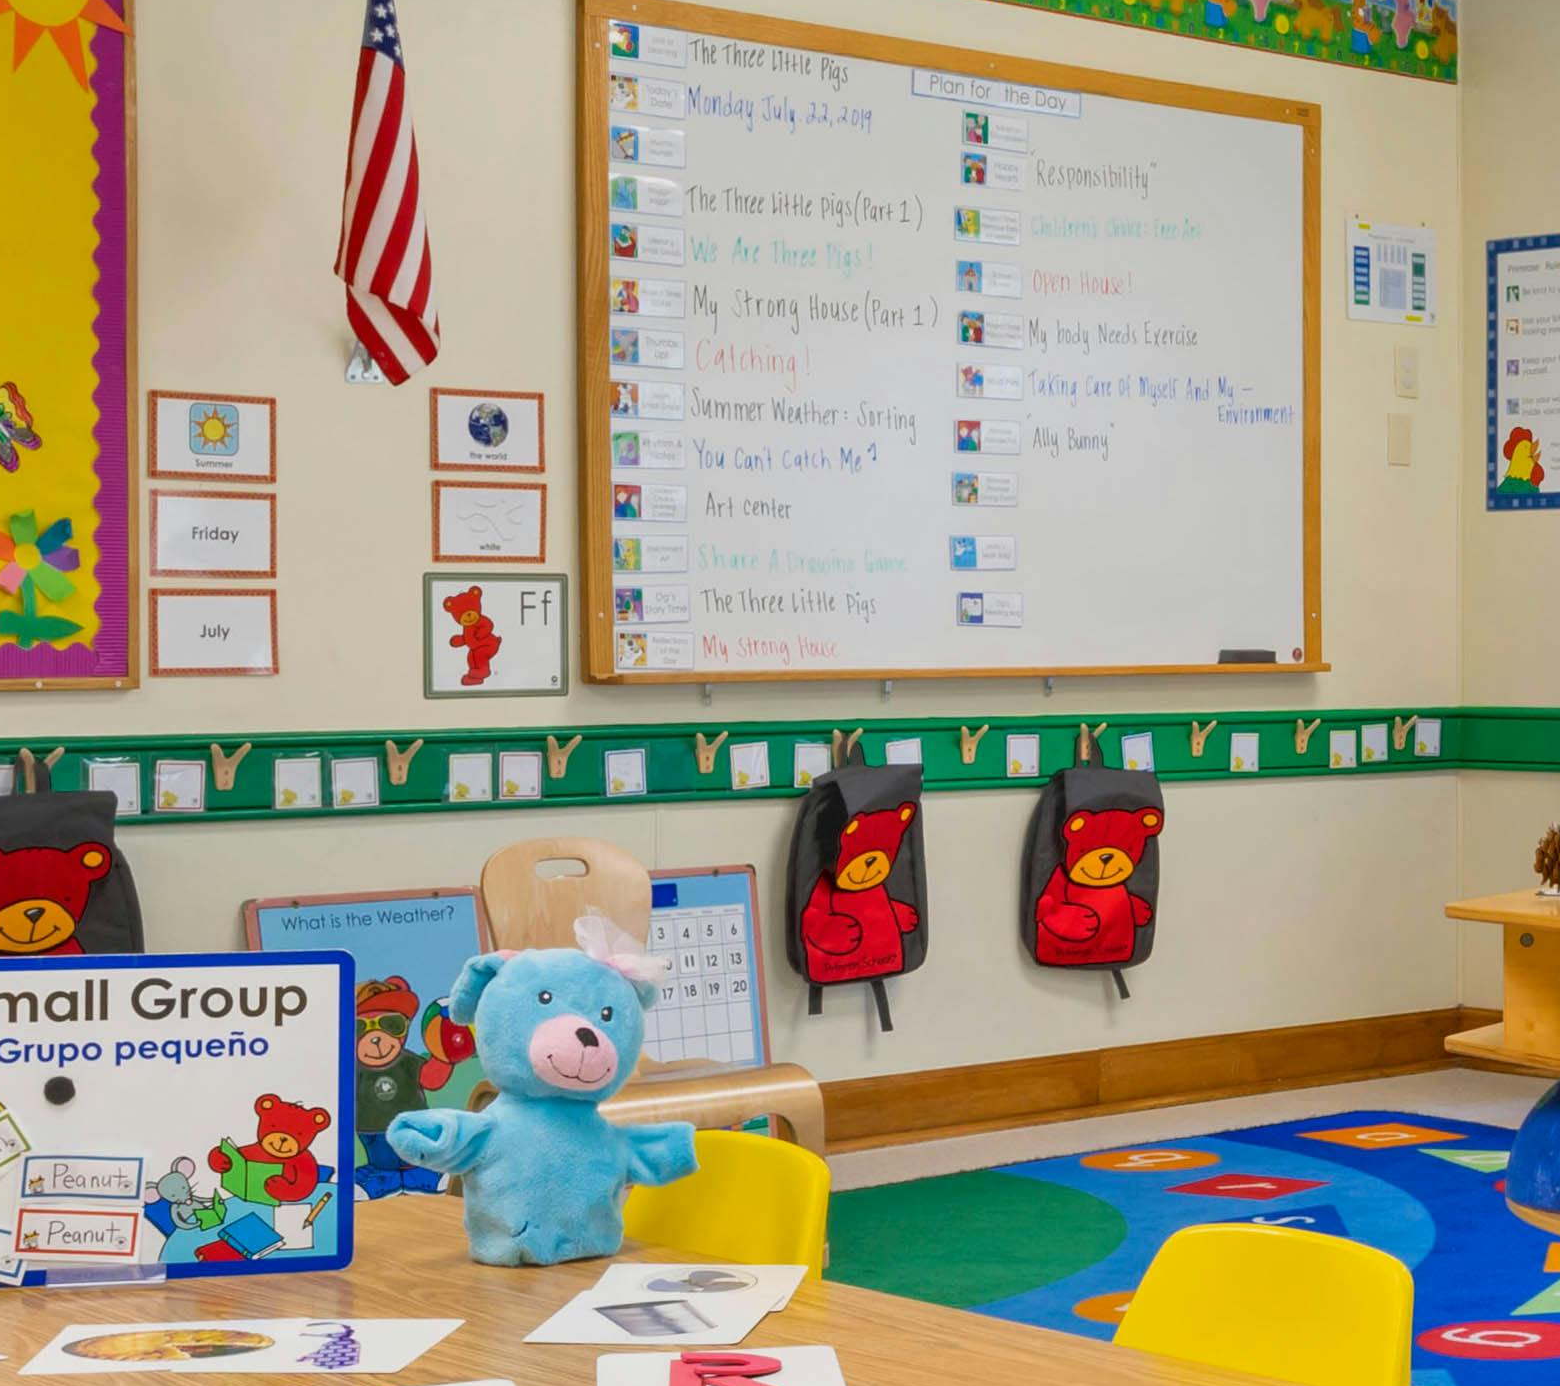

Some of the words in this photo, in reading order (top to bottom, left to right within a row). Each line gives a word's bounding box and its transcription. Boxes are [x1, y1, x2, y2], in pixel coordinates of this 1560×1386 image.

[690, 39, 717, 65] The
[723, 42, 765, 68] Three
[771, 49, 813, 76] Little
[821, 56, 849, 93] Pigs
[929, 74, 965, 95] Plan
[970, 79, 991, 99] for
[1004, 85, 1032, 105] the
[1035, 88, 1068, 111] Day
[687, 86, 754, 133] Monday
[837, 106, 873, 134] 2019
[685, 185, 717, 214] The
[722, 187, 764, 215] Three
[771, 190, 813, 218] Little
[690, 236, 718, 263] We
[732, 236, 760, 264] Are
[771, 240, 817, 267] Three
[693, 284, 719, 335] My
[735, 288, 800, 335] Strong
[809, 292, 859, 323] House
[1028, 319, 1049, 354] My
[1098, 323, 1137, 346] Needs
[1144, 320, 1198, 346] Exercise
[1027, 368, 1078, 407] Taking
[1085, 375, 1112, 397] Care
[1186, 376, 1209, 401] And
[1217, 376, 1235, 406] My
[690, 386, 765, 422] Summer
[856, 400, 917, 445] Sorting
[1217, 404, 1295, 425] Environment
[195, 459, 233, 469] Summer
[693, 438, 725, 469] You
[735, 446, 772, 471] Can't
[705, 490, 734, 518] Art
[192, 526, 239, 543] Friday
[700, 589, 733, 614] The
[738, 589, 785, 614] Three
[791, 587, 837, 613] Little
[846, 592, 877, 624] Pigs
[200, 624, 230, 641] July
[702, 634, 728, 663] My
[281, 915, 328, 932] What
[331, 915, 342, 929] is
[345, 913, 371, 928] the
[374, 905, 456, 926] Weather?
[657, 928, 665, 939] 3
[682, 928, 690, 939] 4
[706, 925, 713, 936] 5
[731, 923, 737, 935] 6
[684, 955, 695, 967] 11
[706, 955, 718, 966] 12
[730, 953, 742, 964] 13
[130, 979, 310, 1028] Group
[662, 988, 674, 1000] 17
[684, 985, 697, 997] 18
[708, 983, 720, 995] 19
[733, 980, 747, 992] 20
[114, 1030, 270, 1068] pequeño
[52, 1163, 128, 1189] Peanut
[47, 1220, 121, 1245] Peanut
